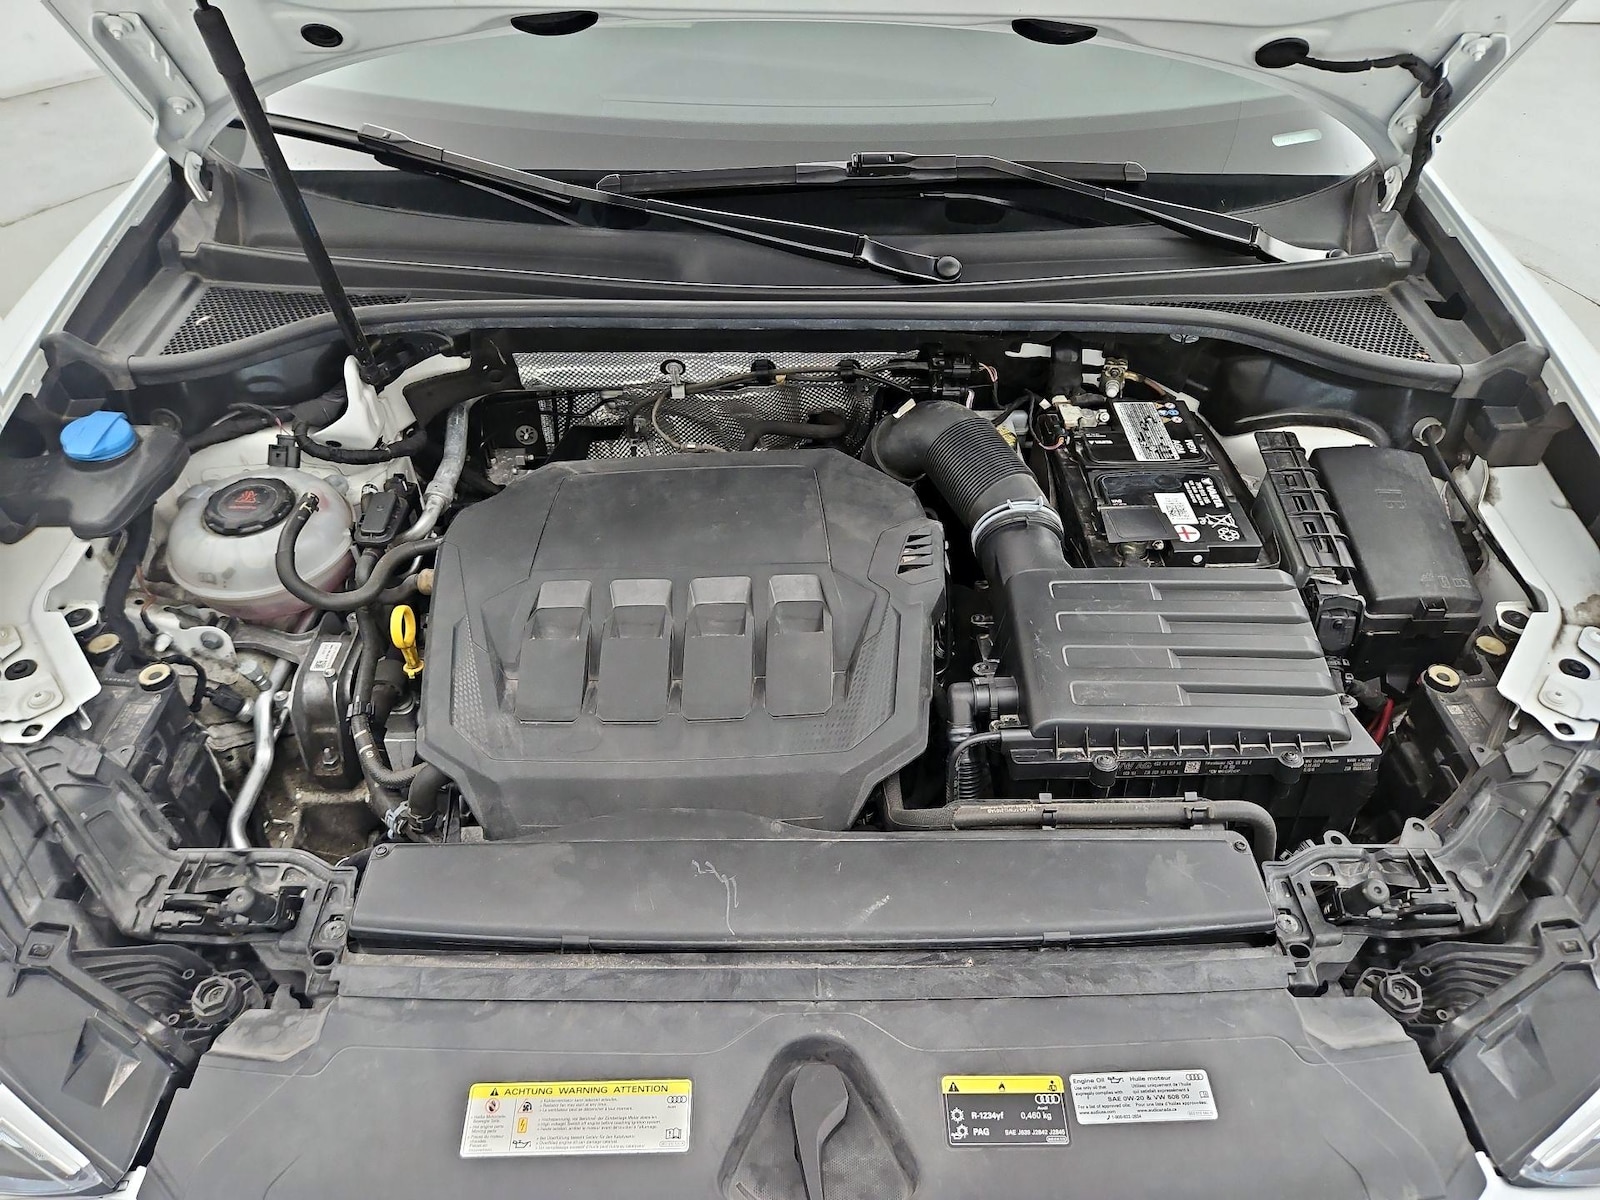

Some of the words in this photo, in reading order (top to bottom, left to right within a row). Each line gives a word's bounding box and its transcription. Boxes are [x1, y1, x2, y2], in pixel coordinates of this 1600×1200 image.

[1206, 485, 1225, 509] VARTA
[559, 1086, 608, 1094] WARNING
[614, 1085, 668, 1093] ATTENTION
[971, 1111, 1004, 1120] R-1234yf
[1042, 1111, 1052, 1121] kg
[972, 1128, 990, 1136] PAG
